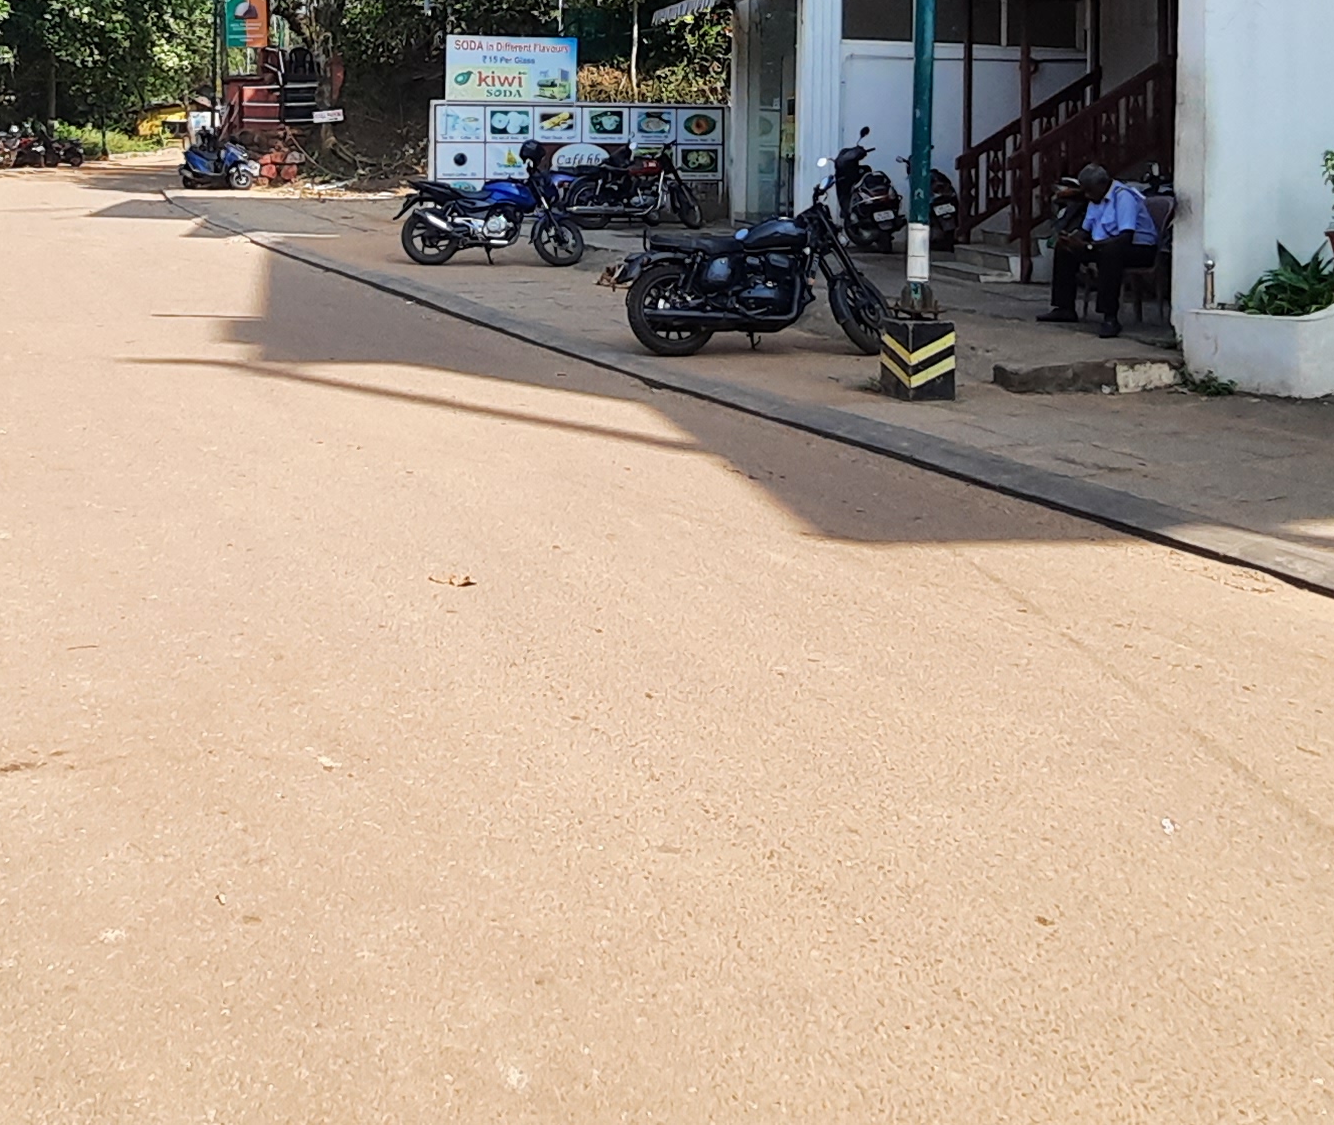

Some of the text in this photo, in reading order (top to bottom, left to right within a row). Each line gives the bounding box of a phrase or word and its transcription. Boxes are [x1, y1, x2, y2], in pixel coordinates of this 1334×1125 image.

[454, 39, 570, 54] SODA in Different Flavours
[499, 56, 512, 64] Per
[476, 70, 524, 89] kiwi
[485, 89, 523, 99] SODA
